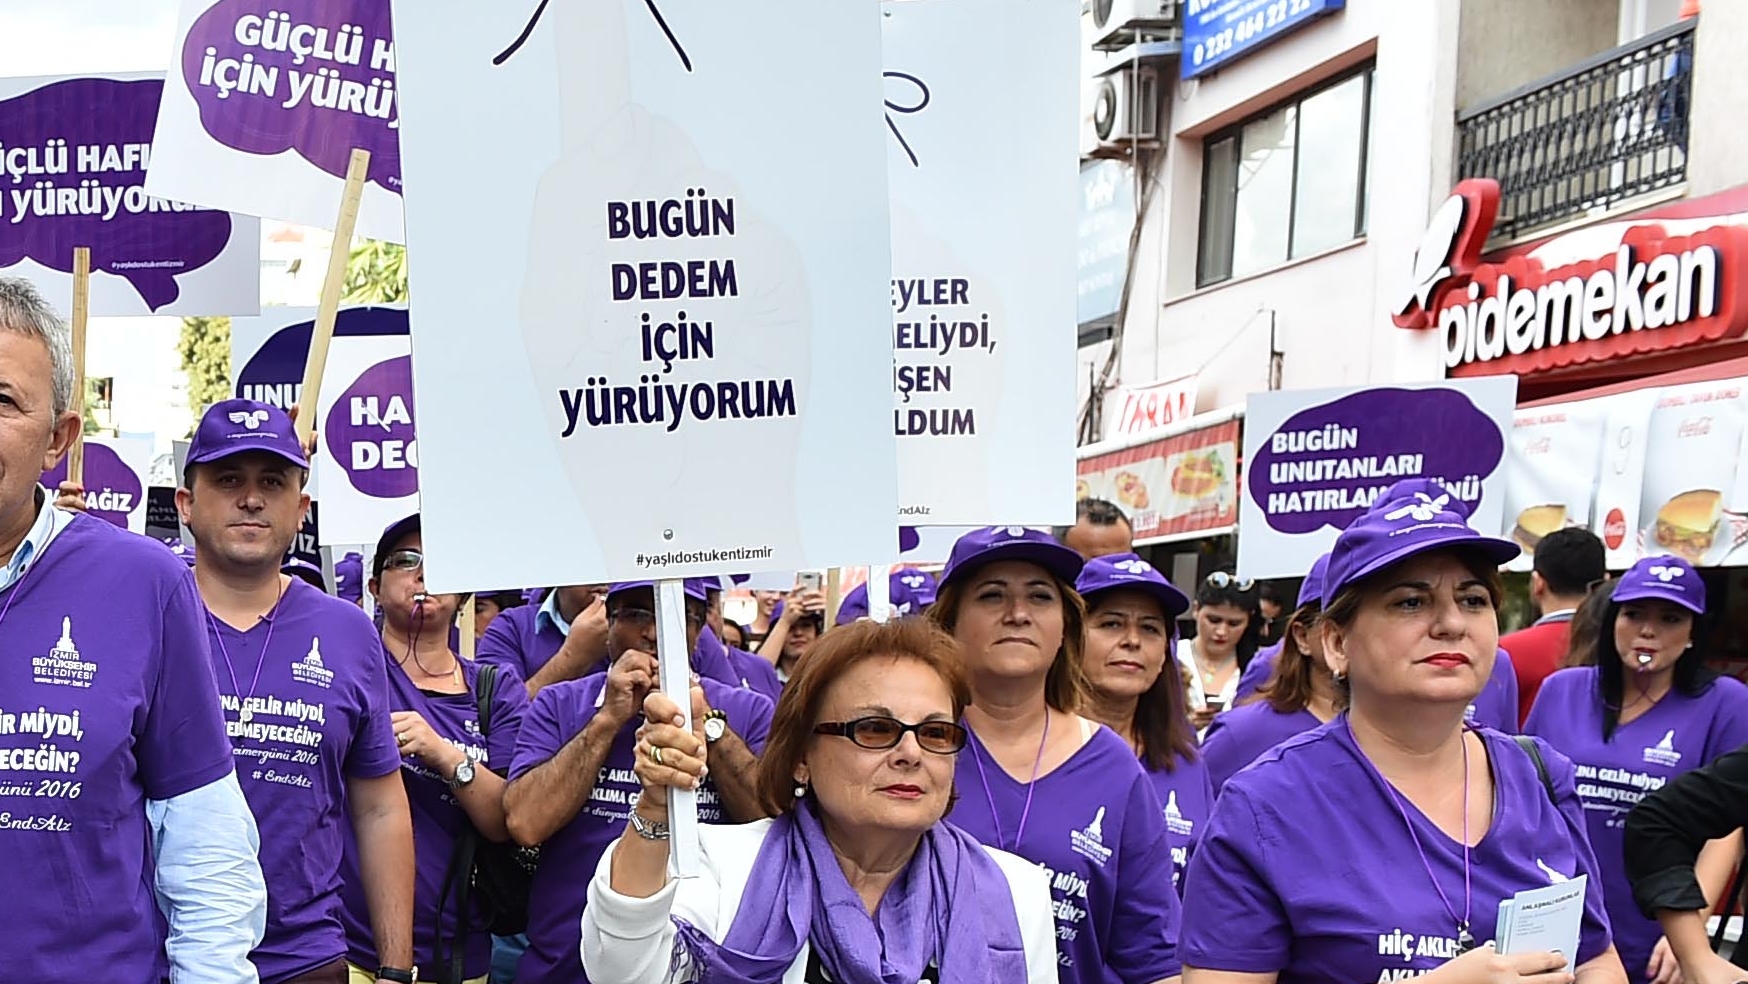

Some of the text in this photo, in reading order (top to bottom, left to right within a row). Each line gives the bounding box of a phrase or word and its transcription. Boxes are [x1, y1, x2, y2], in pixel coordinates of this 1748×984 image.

[235, 11, 363, 65] GÜÇLÜ
[200, 47, 399, 128] İÇİN YÜRÜ
[78, 143, 152, 174] HAFI
[11, 181, 218, 223] YÜRÜYOR
[607, 188, 735, 240] BUGÜN
[612, 259, 739, 301] DEDEM
[892, 279, 970, 313] YLER
[1439, 244, 1716, 368] pidemekan
[642, 311, 714, 373] İÇİN
[896, 314, 996, 355] ELİYDİ,
[559, 374, 797, 437] YÜRÜYORUM
[894, 409, 975, 436] LDUM
[1272, 424, 1358, 453] BUGÜN
[1270, 454, 1423, 484] UNUTANLARI
[636, 546, 773, 568] #yaşlıdostukentizmir
[19, 706, 84, 741] MİYDİ,
[284, 698, 325, 726] MİYDİ,
[291, 749, 320, 765] 2016
[34, 779, 82, 799] 2016
[1378, 928, 1414, 961] HİÇ
